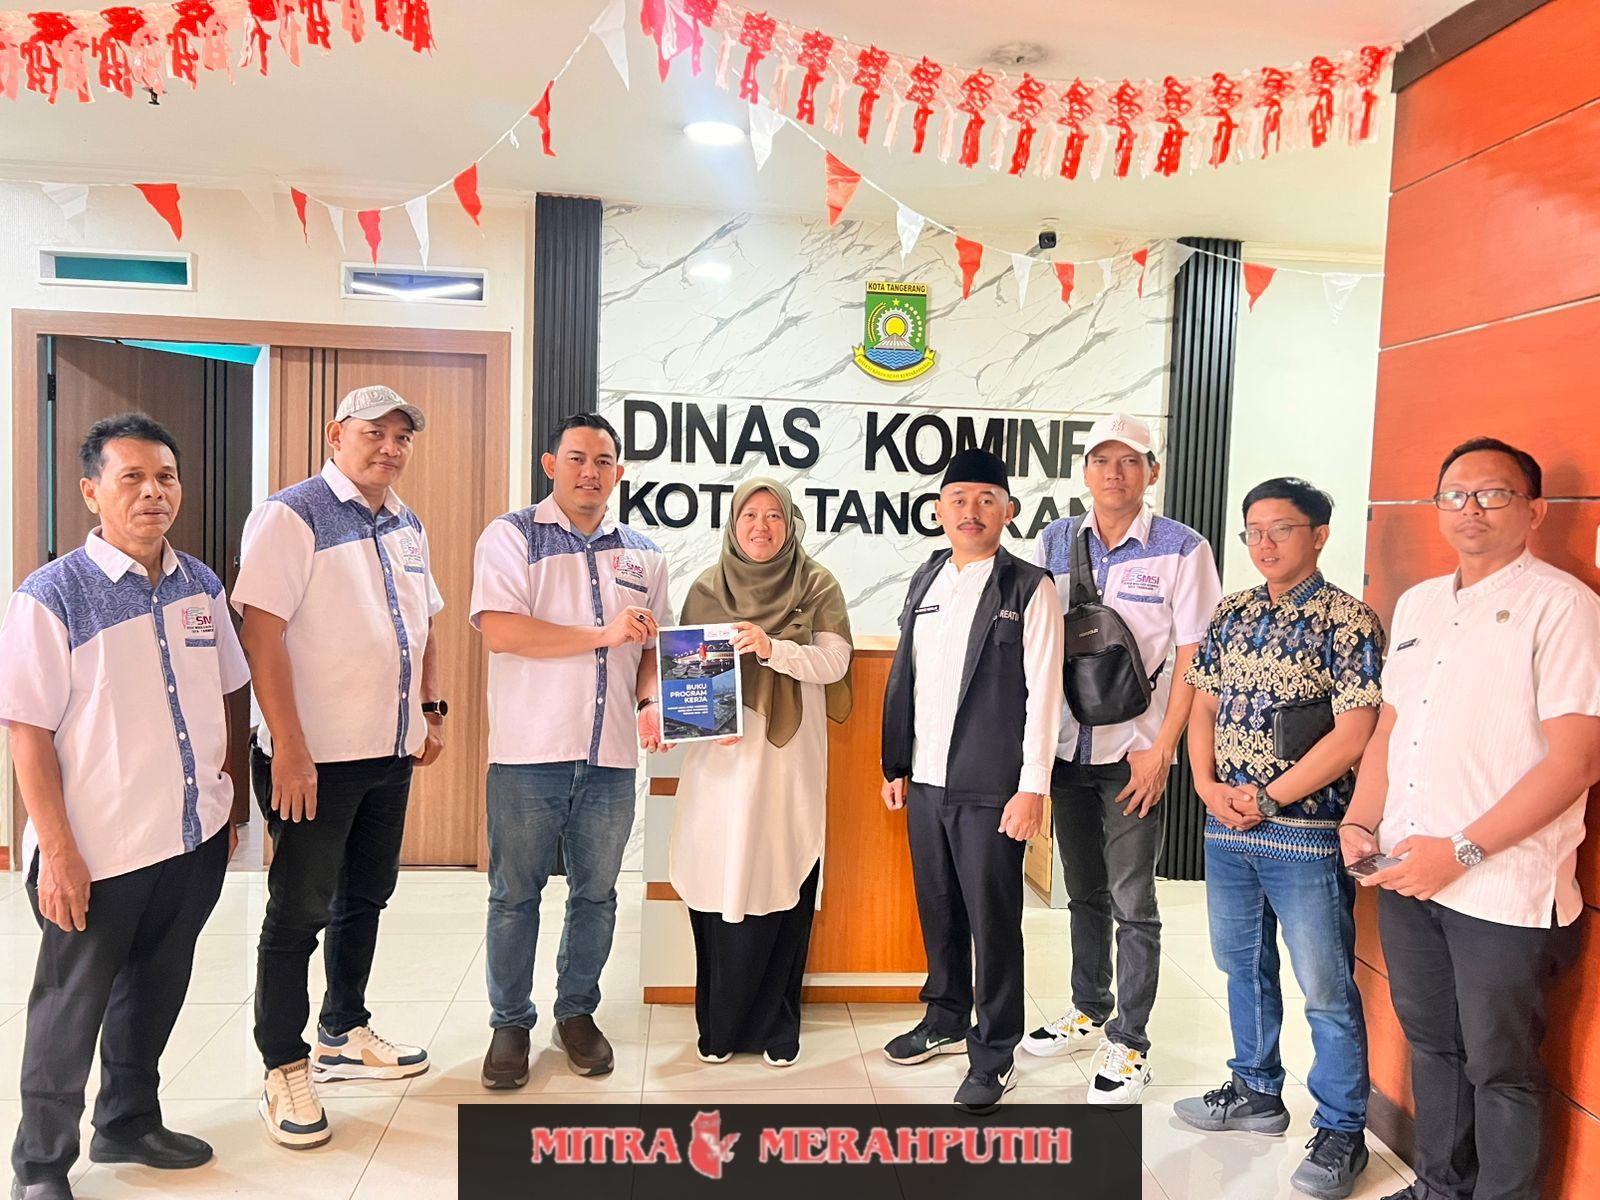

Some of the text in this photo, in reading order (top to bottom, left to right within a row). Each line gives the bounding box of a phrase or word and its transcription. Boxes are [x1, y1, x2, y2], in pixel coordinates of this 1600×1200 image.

[868, 282, 926, 293] KOTA TANGERANG
[623, 399, 1096, 479] DINAS KOMINF
[619, 480, 1089, 540] KOT TANGRA
[1136, 574, 1160, 584] SMSI
[195, 615, 212, 625] SM
[670, 690, 708, 698] PROGRAM
